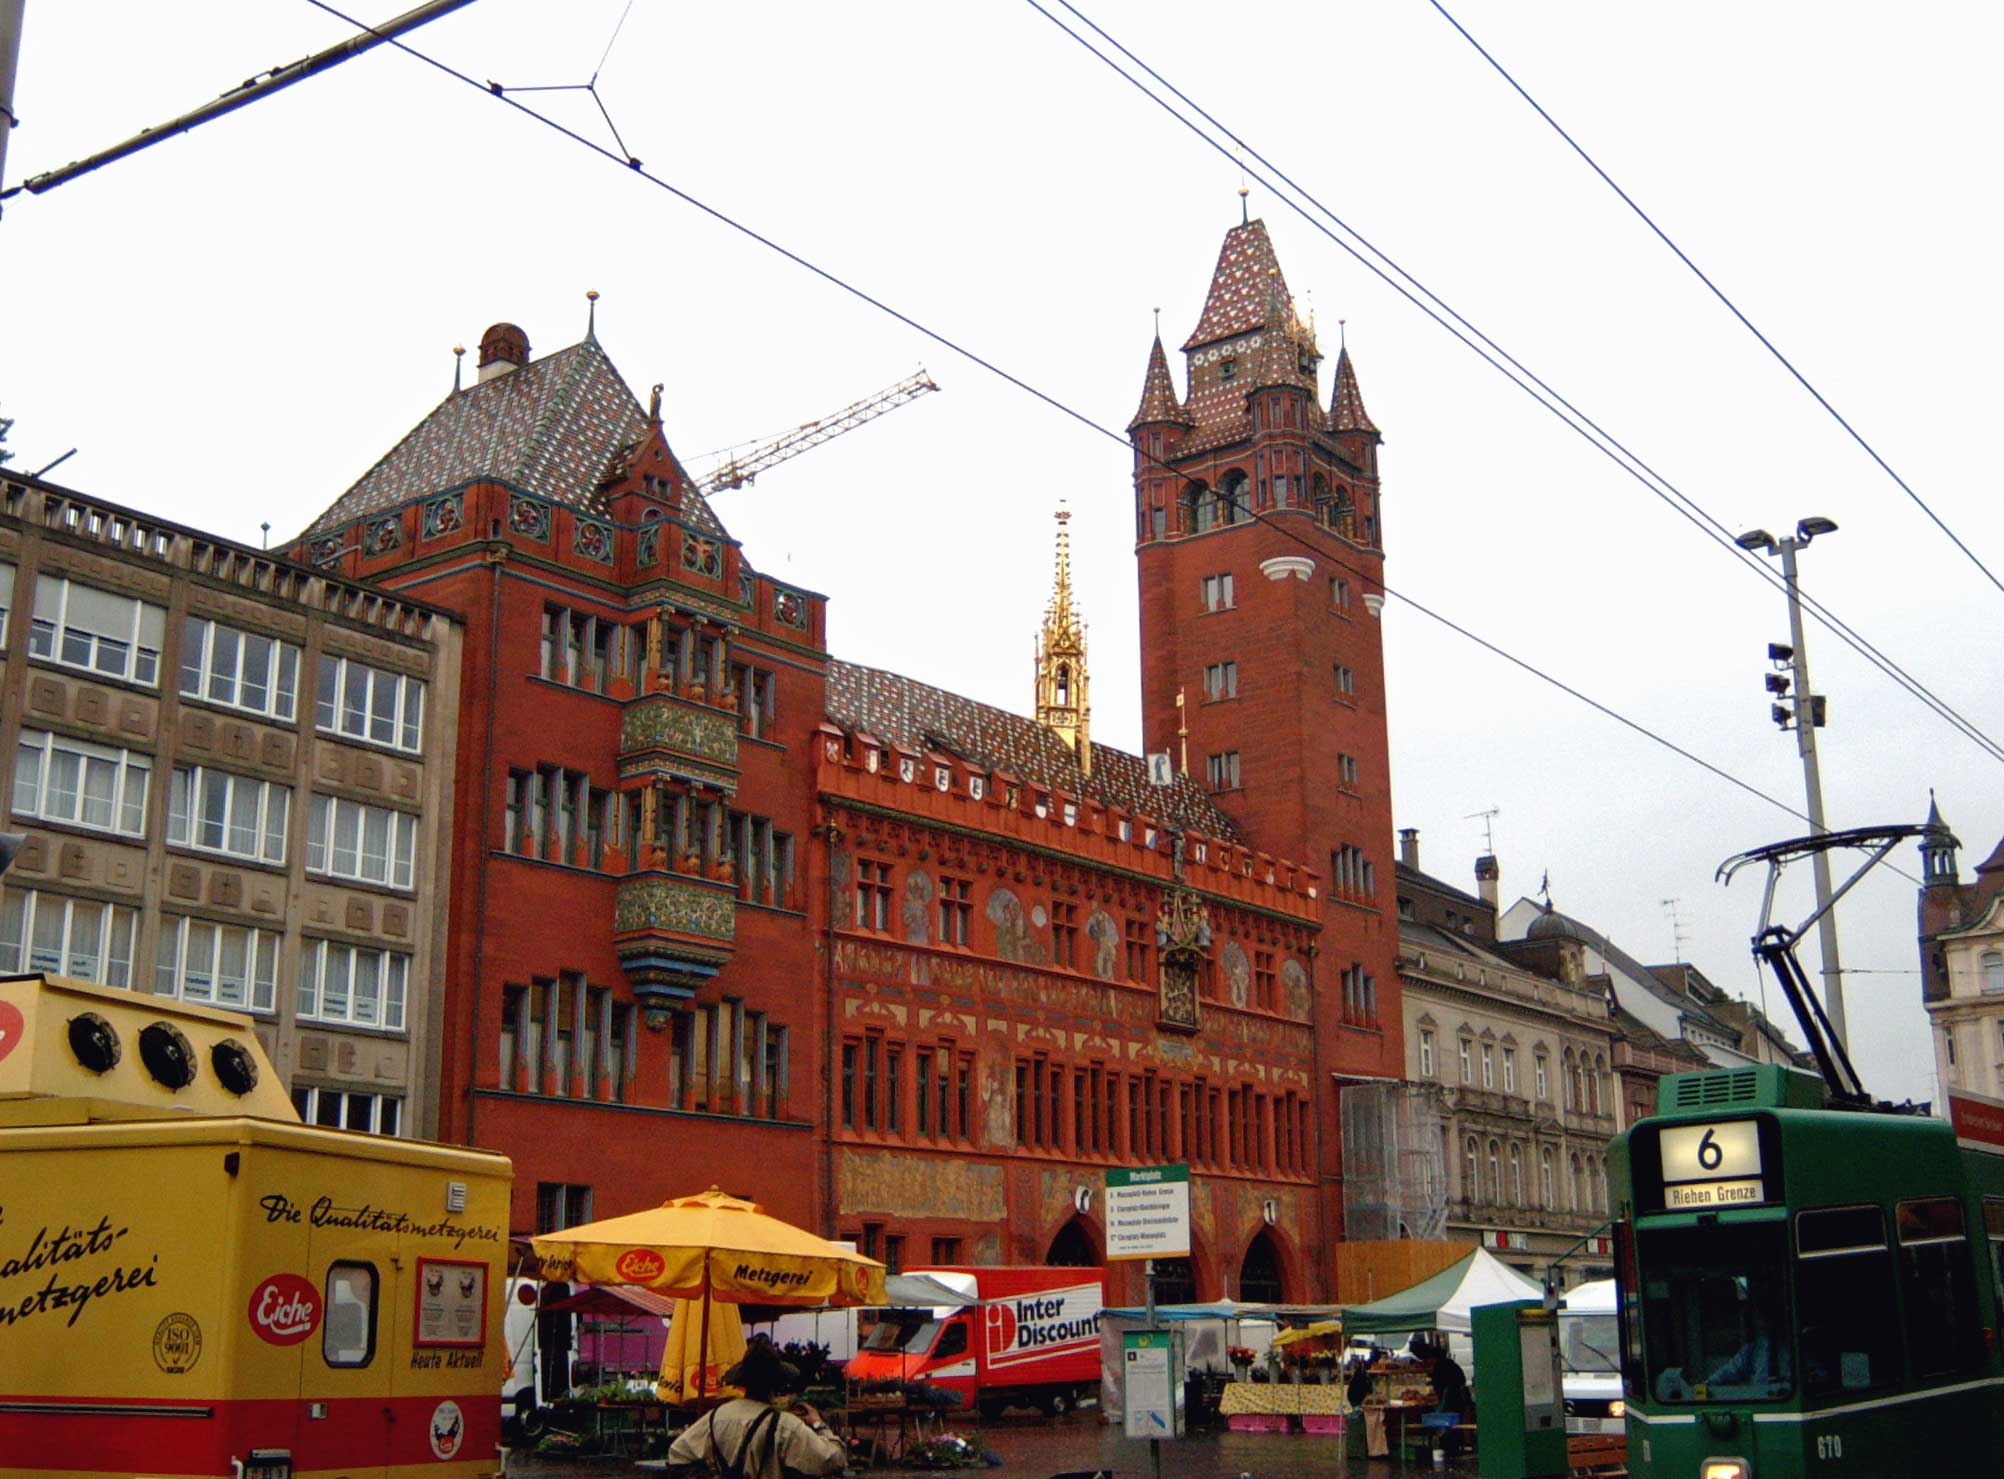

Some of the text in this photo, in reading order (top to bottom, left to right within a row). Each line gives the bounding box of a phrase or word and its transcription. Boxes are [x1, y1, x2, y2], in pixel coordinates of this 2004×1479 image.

[1698, 1128, 1723, 1170] 6
[1673, 1186, 1756, 1205] Riehen Grenze
[260, 1194, 499, 1250] Die Qualitätsmetzgerei
[621, 1254, 660, 1278] Eiche
[733, 1264, 813, 1288] Metzgerei
[257, 1285, 313, 1335] Eiche
[1017, 1298, 1065, 1323] Inter
[167, 1328, 190, 1342] ISO
[1018, 1309, 1102, 1348] Discount
[411, 1350, 484, 1369] Heute Aktuell
[1817, 1435, 1842, 1459] 670
